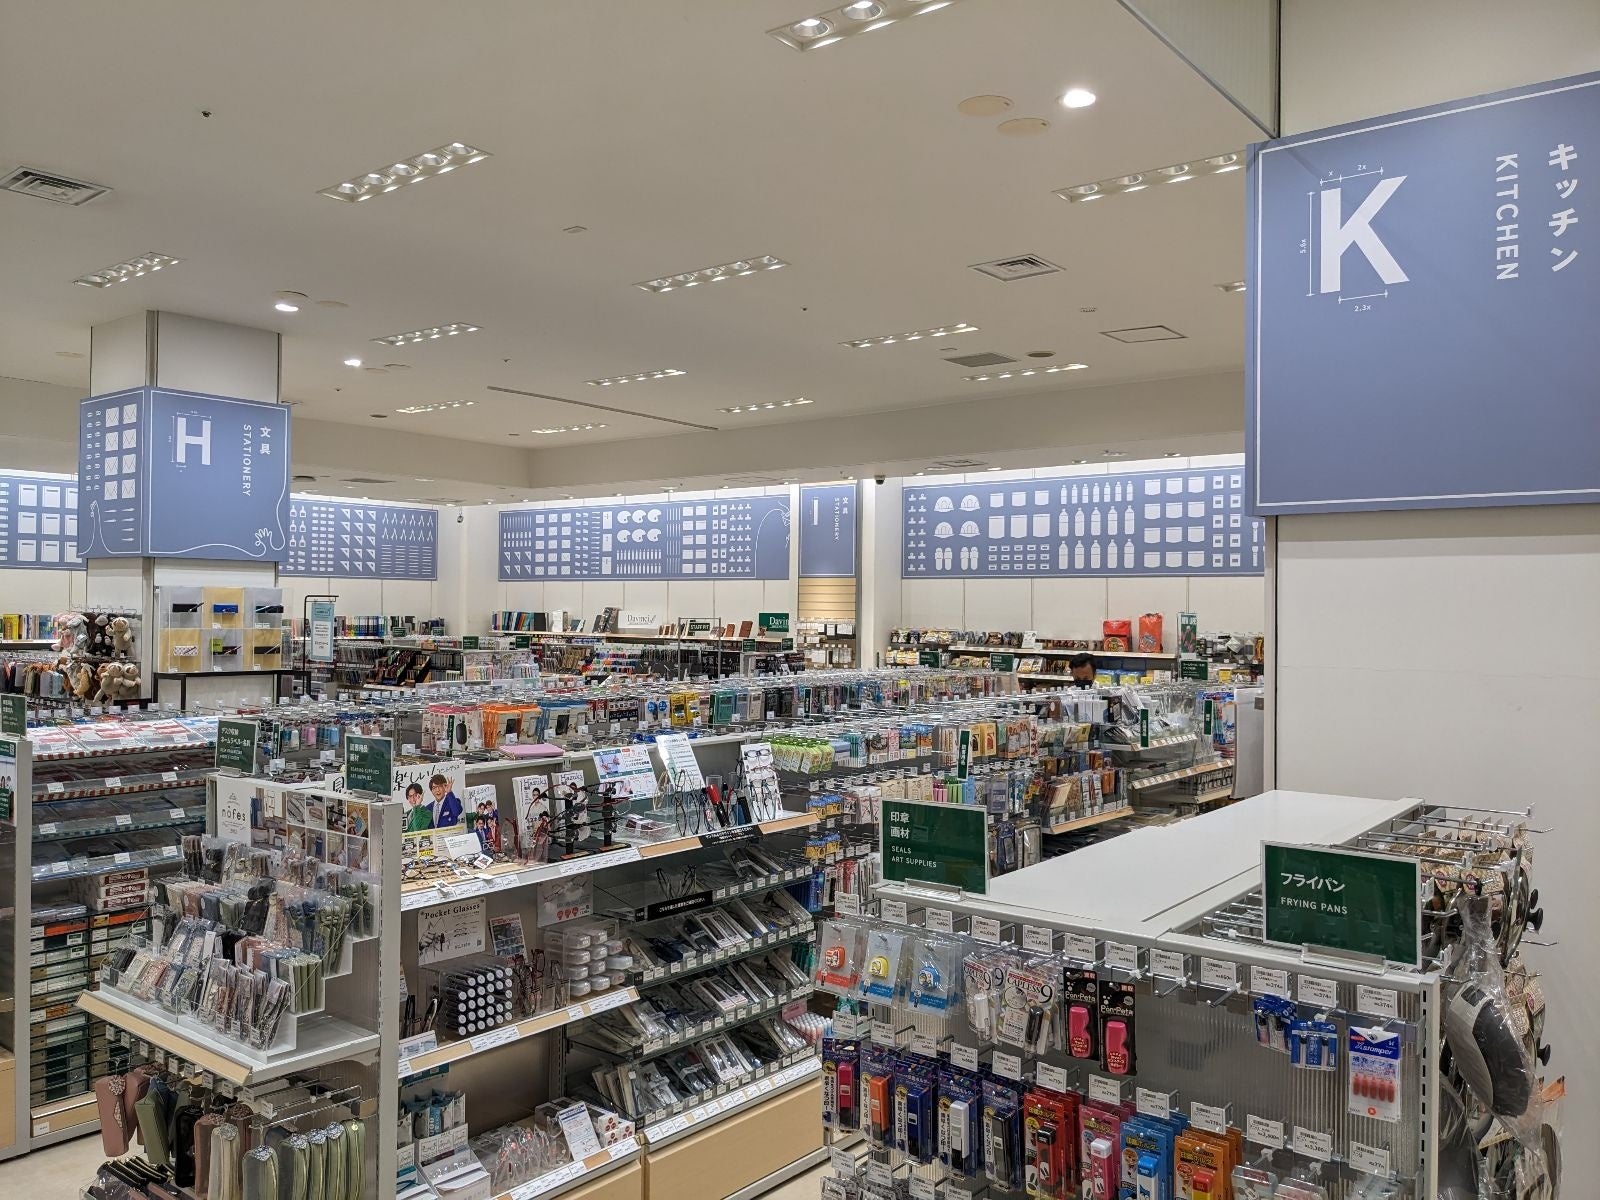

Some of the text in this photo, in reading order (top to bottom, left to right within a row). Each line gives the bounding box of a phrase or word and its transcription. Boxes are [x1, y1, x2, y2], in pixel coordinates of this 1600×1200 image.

[1495, 152, 1519, 281] KITCHEN
[1547, 143, 1579, 273] キッチン
[1320, 174, 1410, 294] K
[176, 416, 211, 466] H
[259, 425, 272, 455] 文具
[242, 423, 252, 497] STATIONERY
[842, 496, 849, 515] 文具
[890, 811, 910, 824] 印章
[890, 826, 910, 839] 画材
[891, 845, 912, 854] SEALS
[891, 855, 937, 868] ART SUPPLIES
[1280, 872, 1345, 893] フライパン
[425, 910, 451, 919] Pocket
[453, 903, 480, 914] Glasses
[1280, 896, 1348, 915] FRYING PANS
[1007, 977, 1054, 1004] CAPLESS 9
